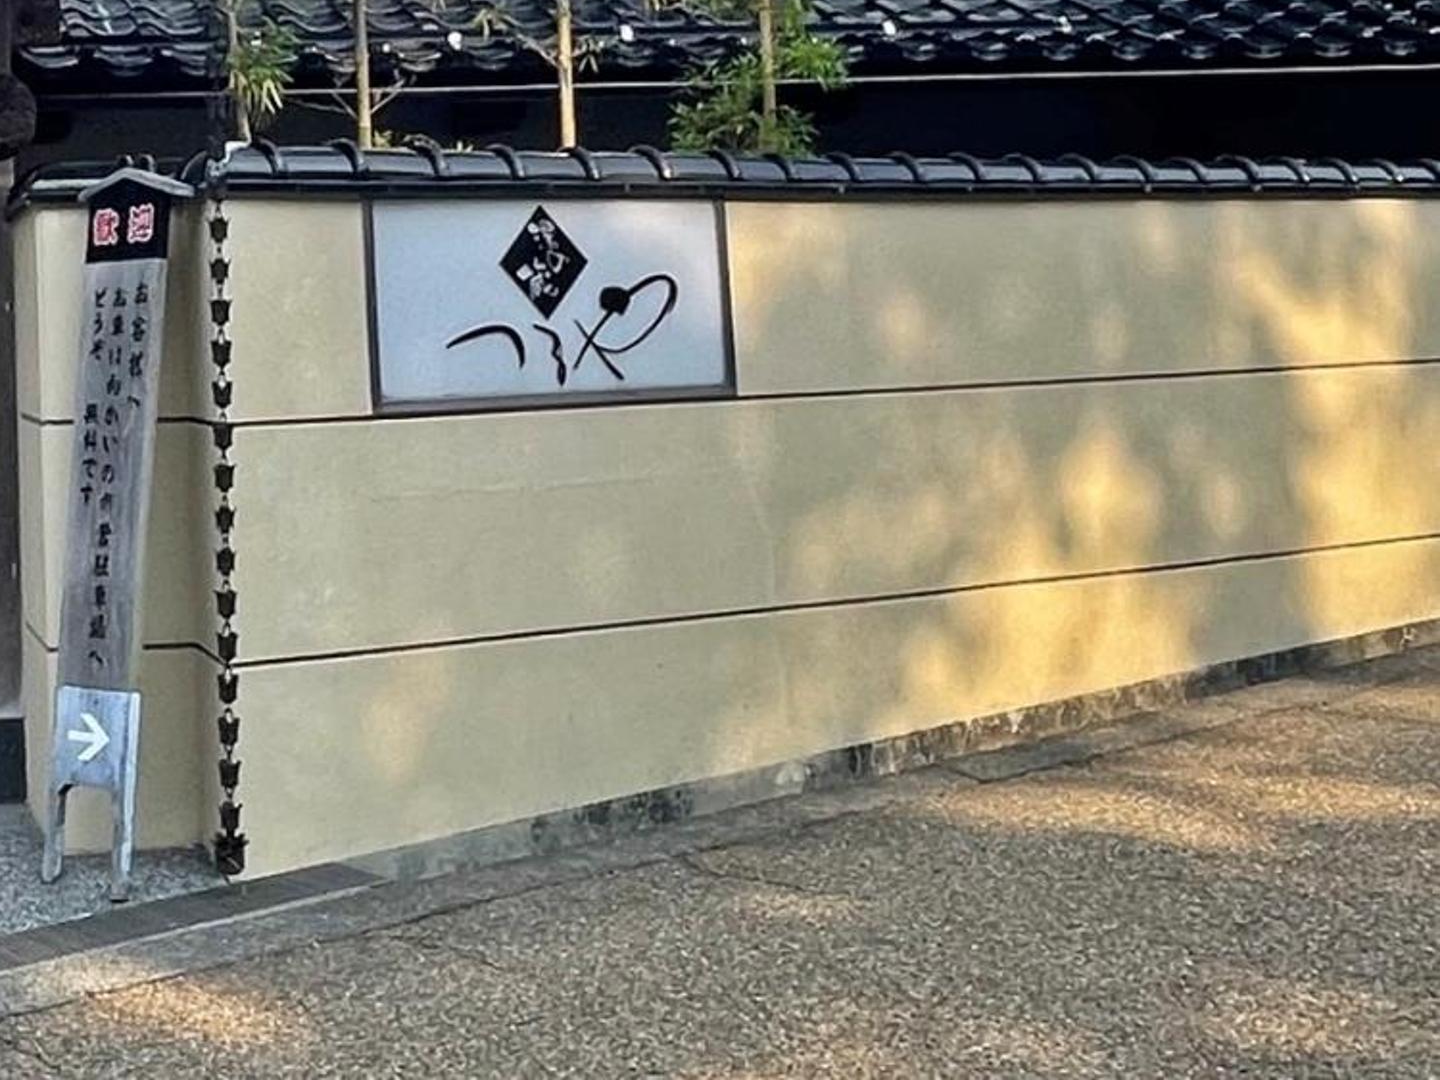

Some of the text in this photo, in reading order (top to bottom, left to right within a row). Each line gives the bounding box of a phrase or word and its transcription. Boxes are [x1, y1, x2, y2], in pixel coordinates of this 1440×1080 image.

[79, 286, 109, 505] どうぞ 無料です
[126, 281, 150, 408] お客様へ
